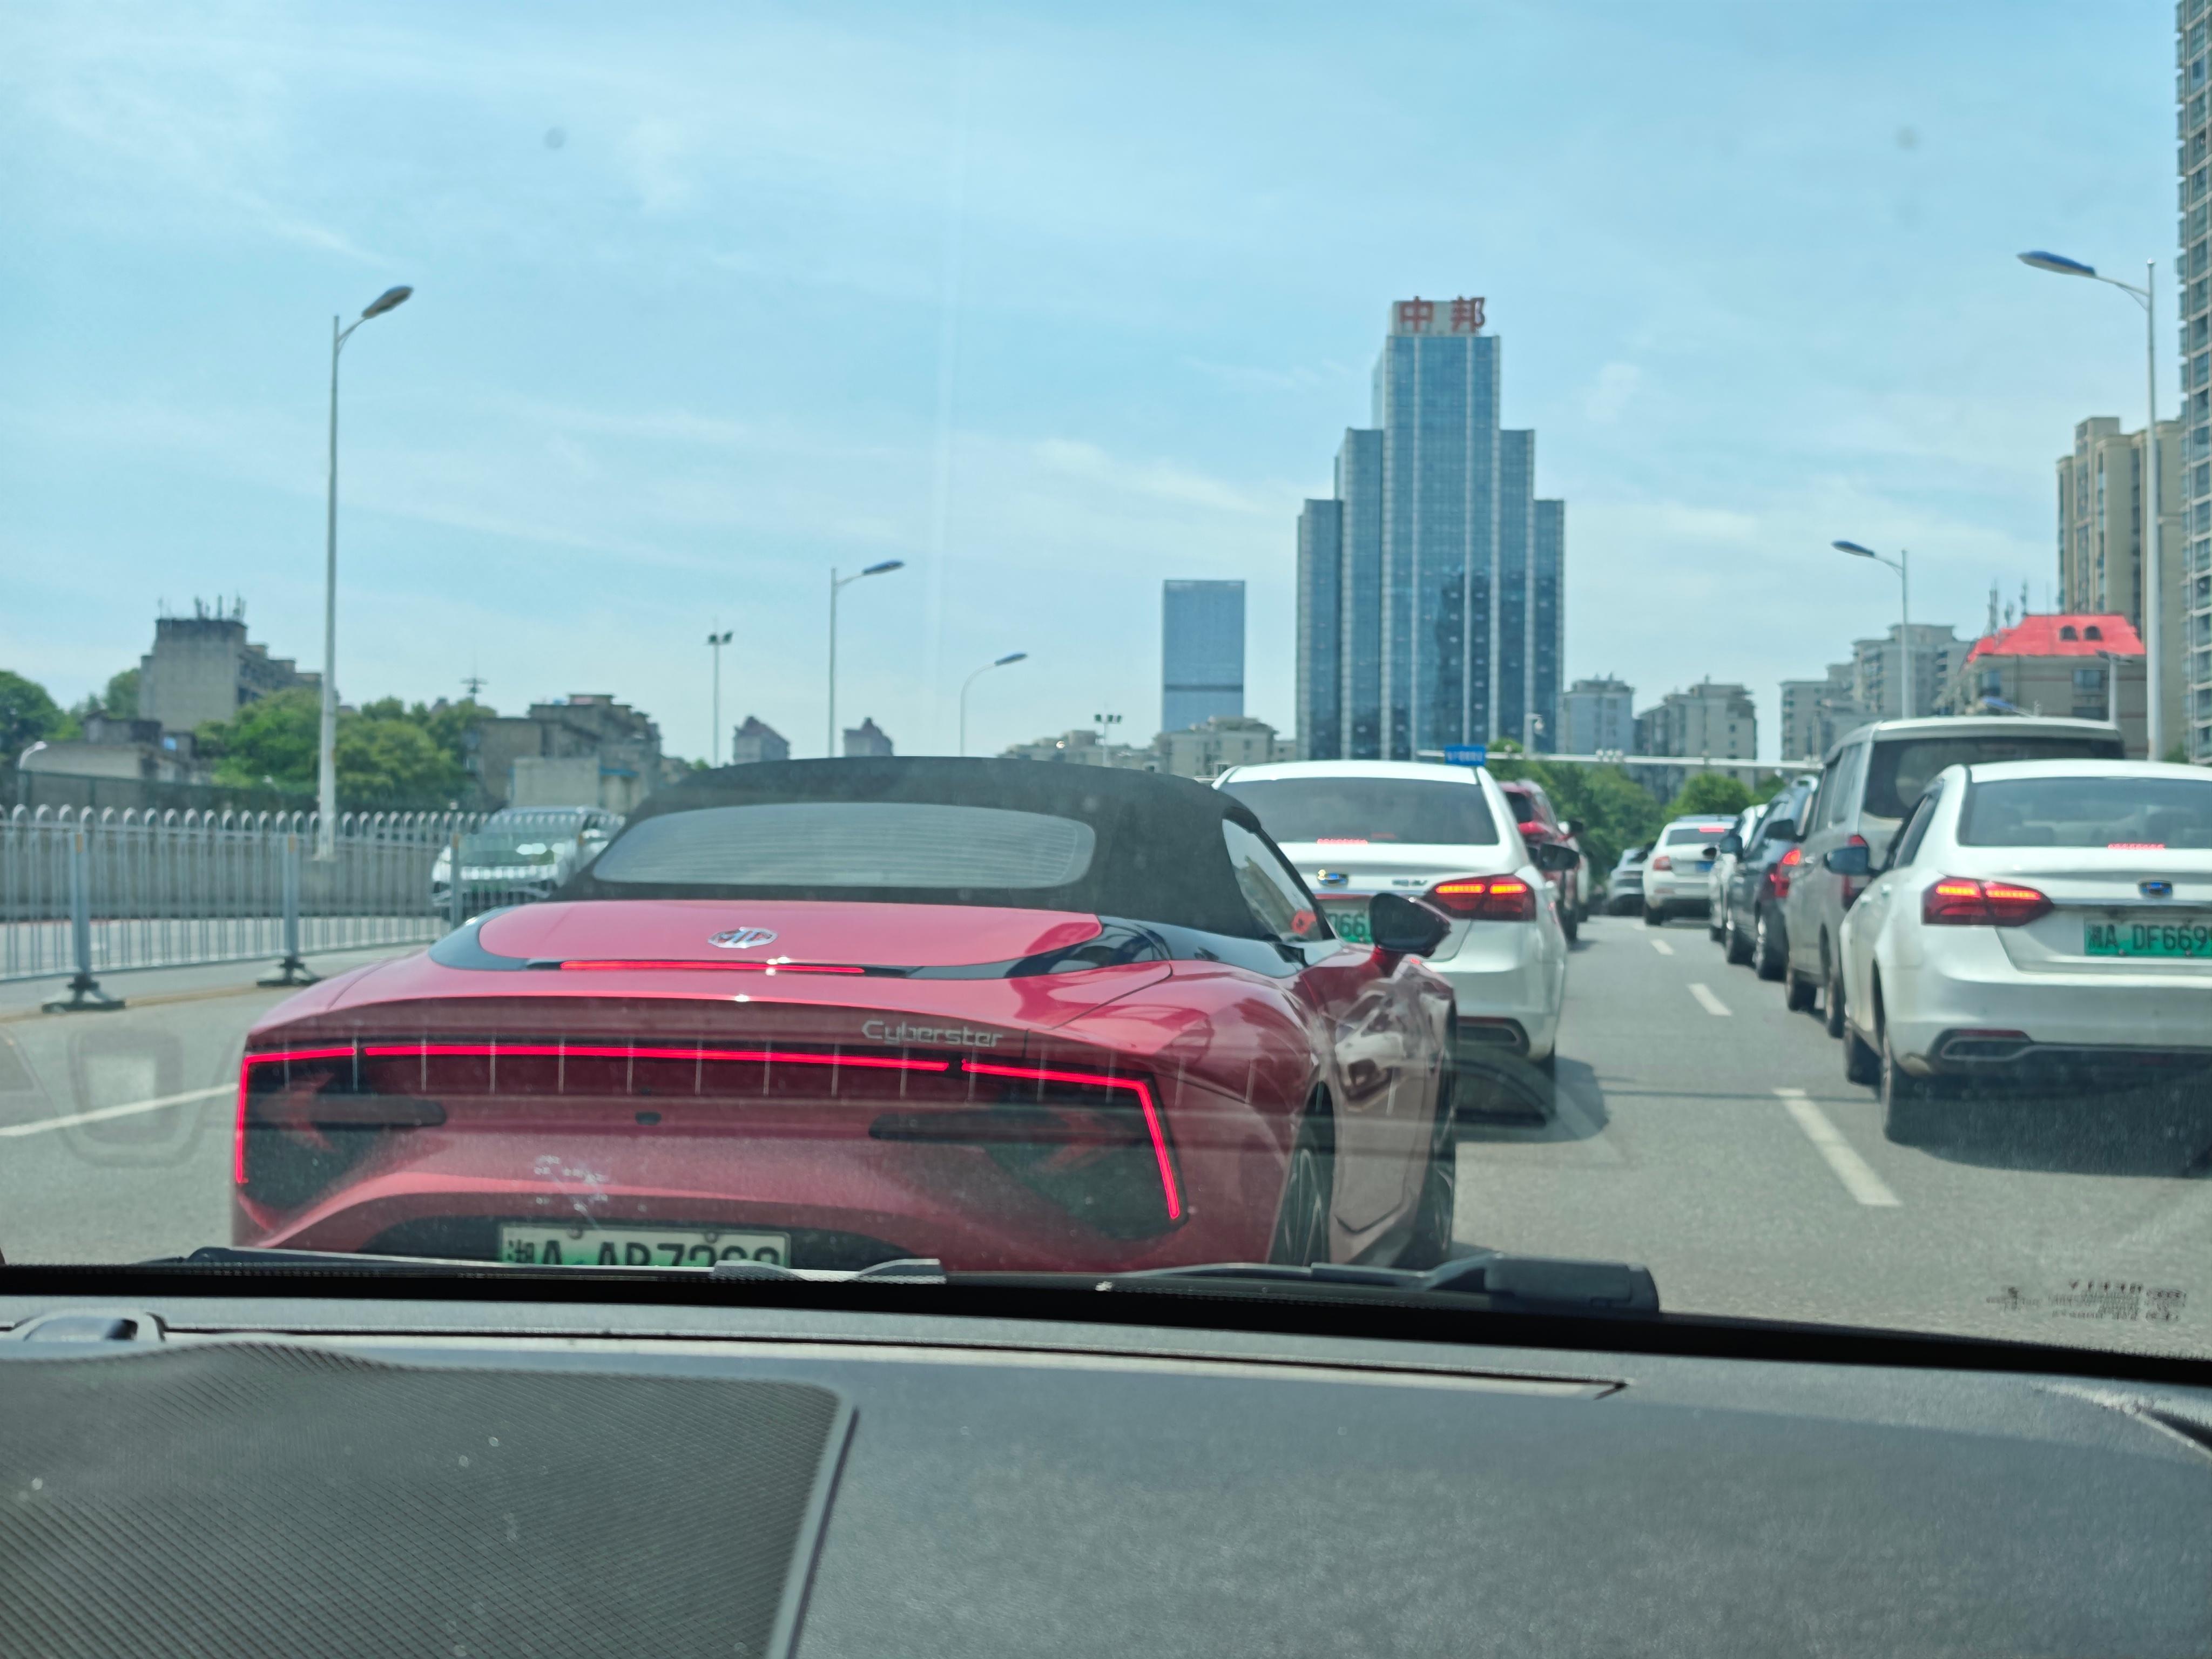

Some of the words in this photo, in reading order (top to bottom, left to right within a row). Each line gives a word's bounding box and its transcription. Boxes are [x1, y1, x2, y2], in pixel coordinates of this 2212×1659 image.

[1400, 295, 1486, 333] 中邦
[2132, 923, 2212, 951] DF669
[862, 1020, 1003, 1047] Cyberster
